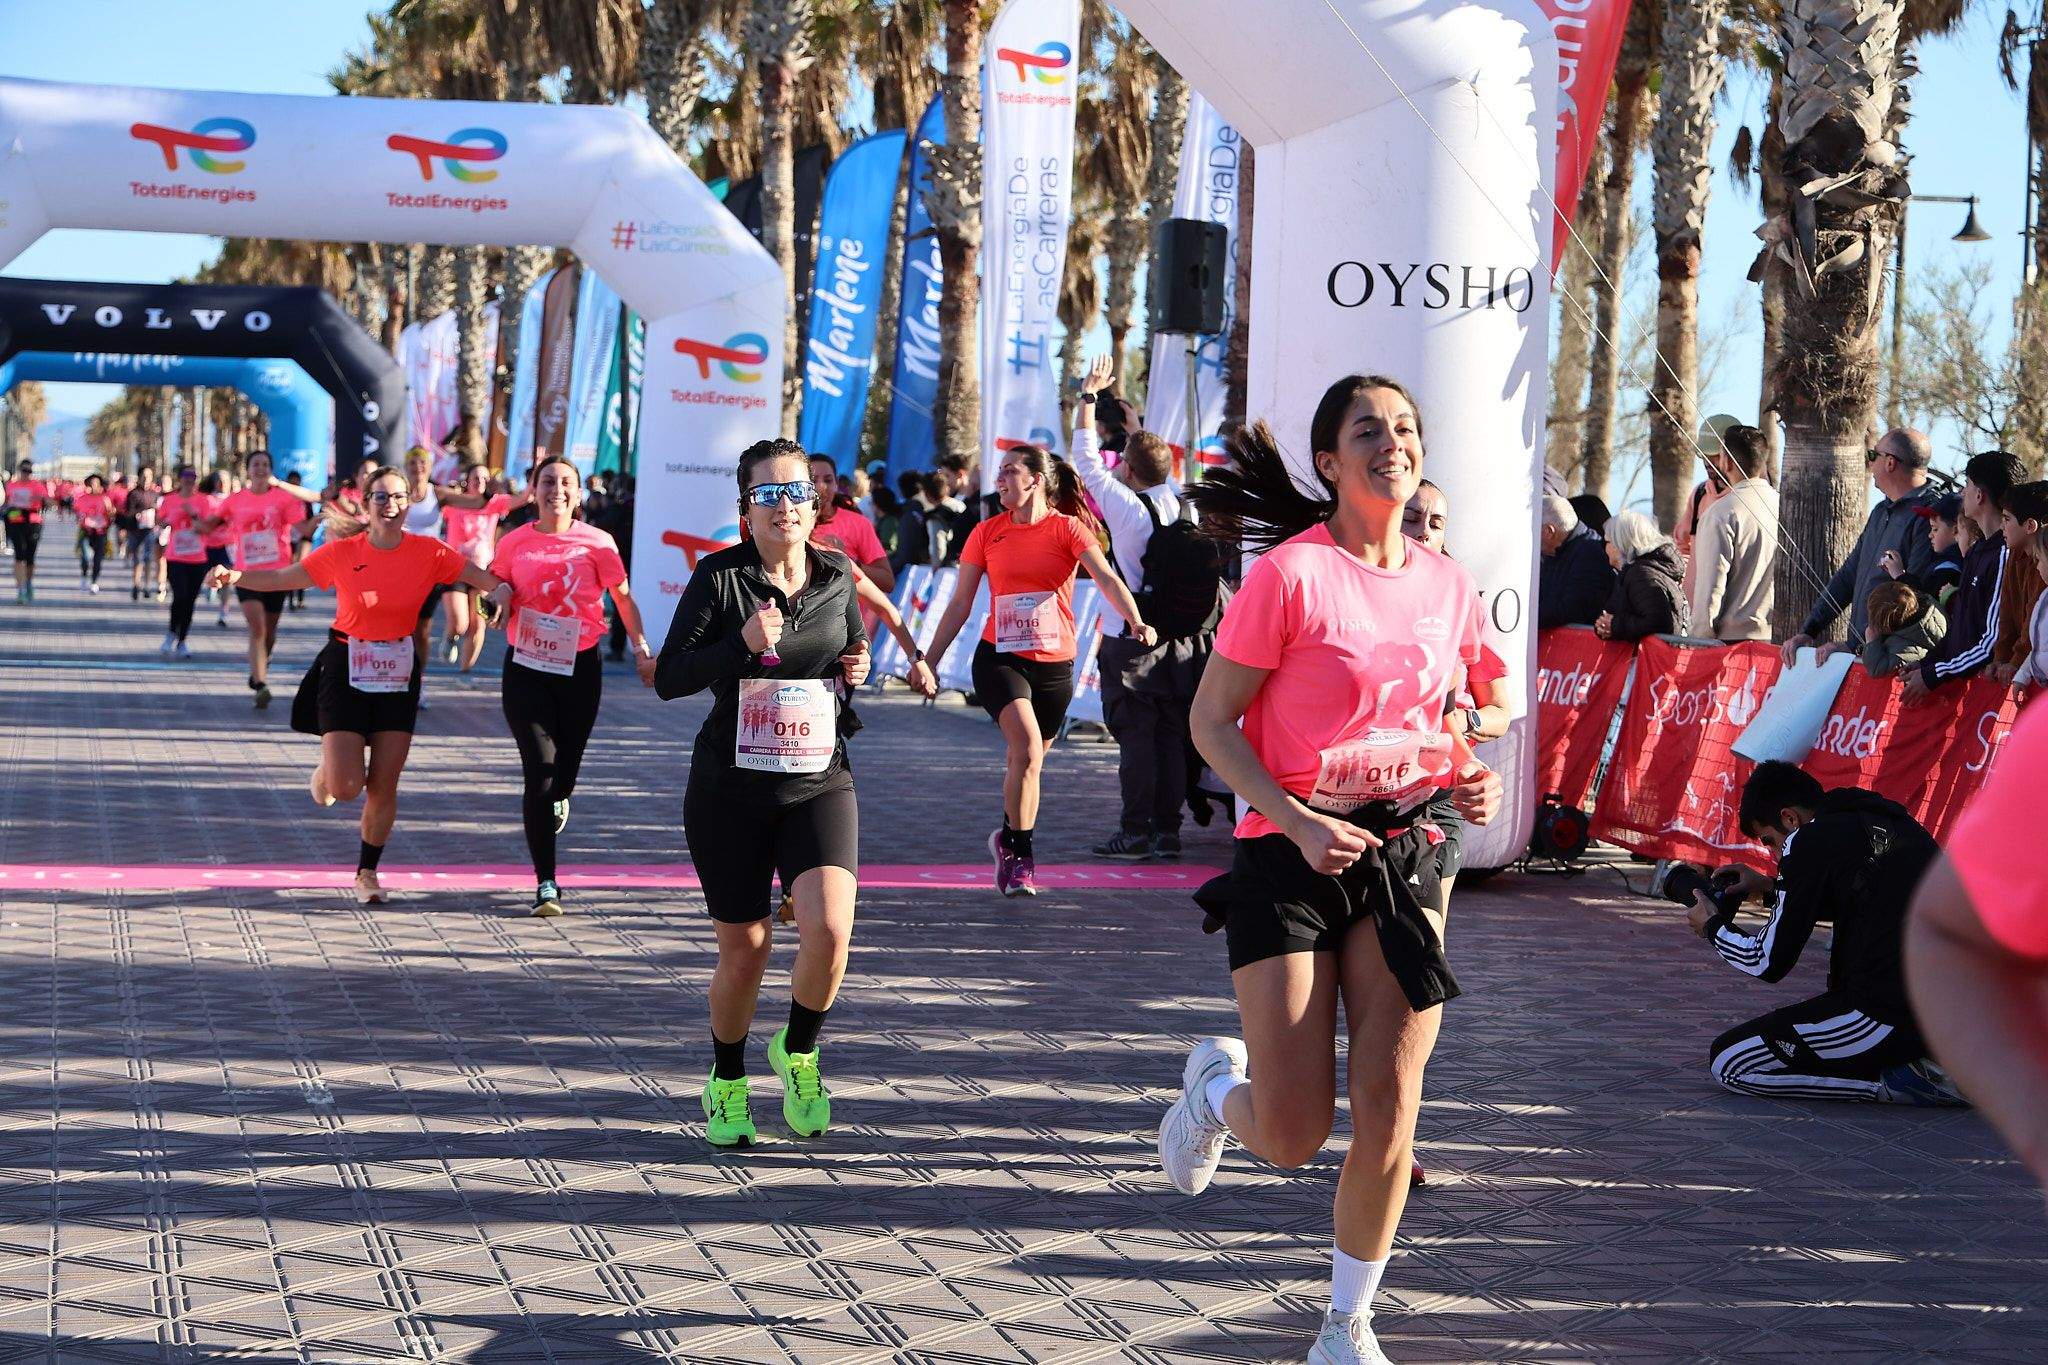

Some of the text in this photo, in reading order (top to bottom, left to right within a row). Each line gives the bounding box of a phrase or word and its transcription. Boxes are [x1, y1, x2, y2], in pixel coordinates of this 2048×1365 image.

[130, 181, 257, 203] TotalEnergies
[386, 192, 508, 213] TotalEnergies
[1327, 261, 1534, 313] OYSHO
[41, 303, 272, 332] VOLVO
[806, 238, 871, 398] Marlene
[670, 388, 767, 409] TotalEnergies
[1016, 618, 1039, 629] 016
[533, 637, 557, 651] 016
[372, 660, 396, 669] 016
[773, 721, 811, 737] 016
[780, 740, 799, 748] 3410
[747, 757, 780, 766] OYSHO
[1365, 762, 1410, 782] 016
[1371, 784, 1394, 793] 4869
